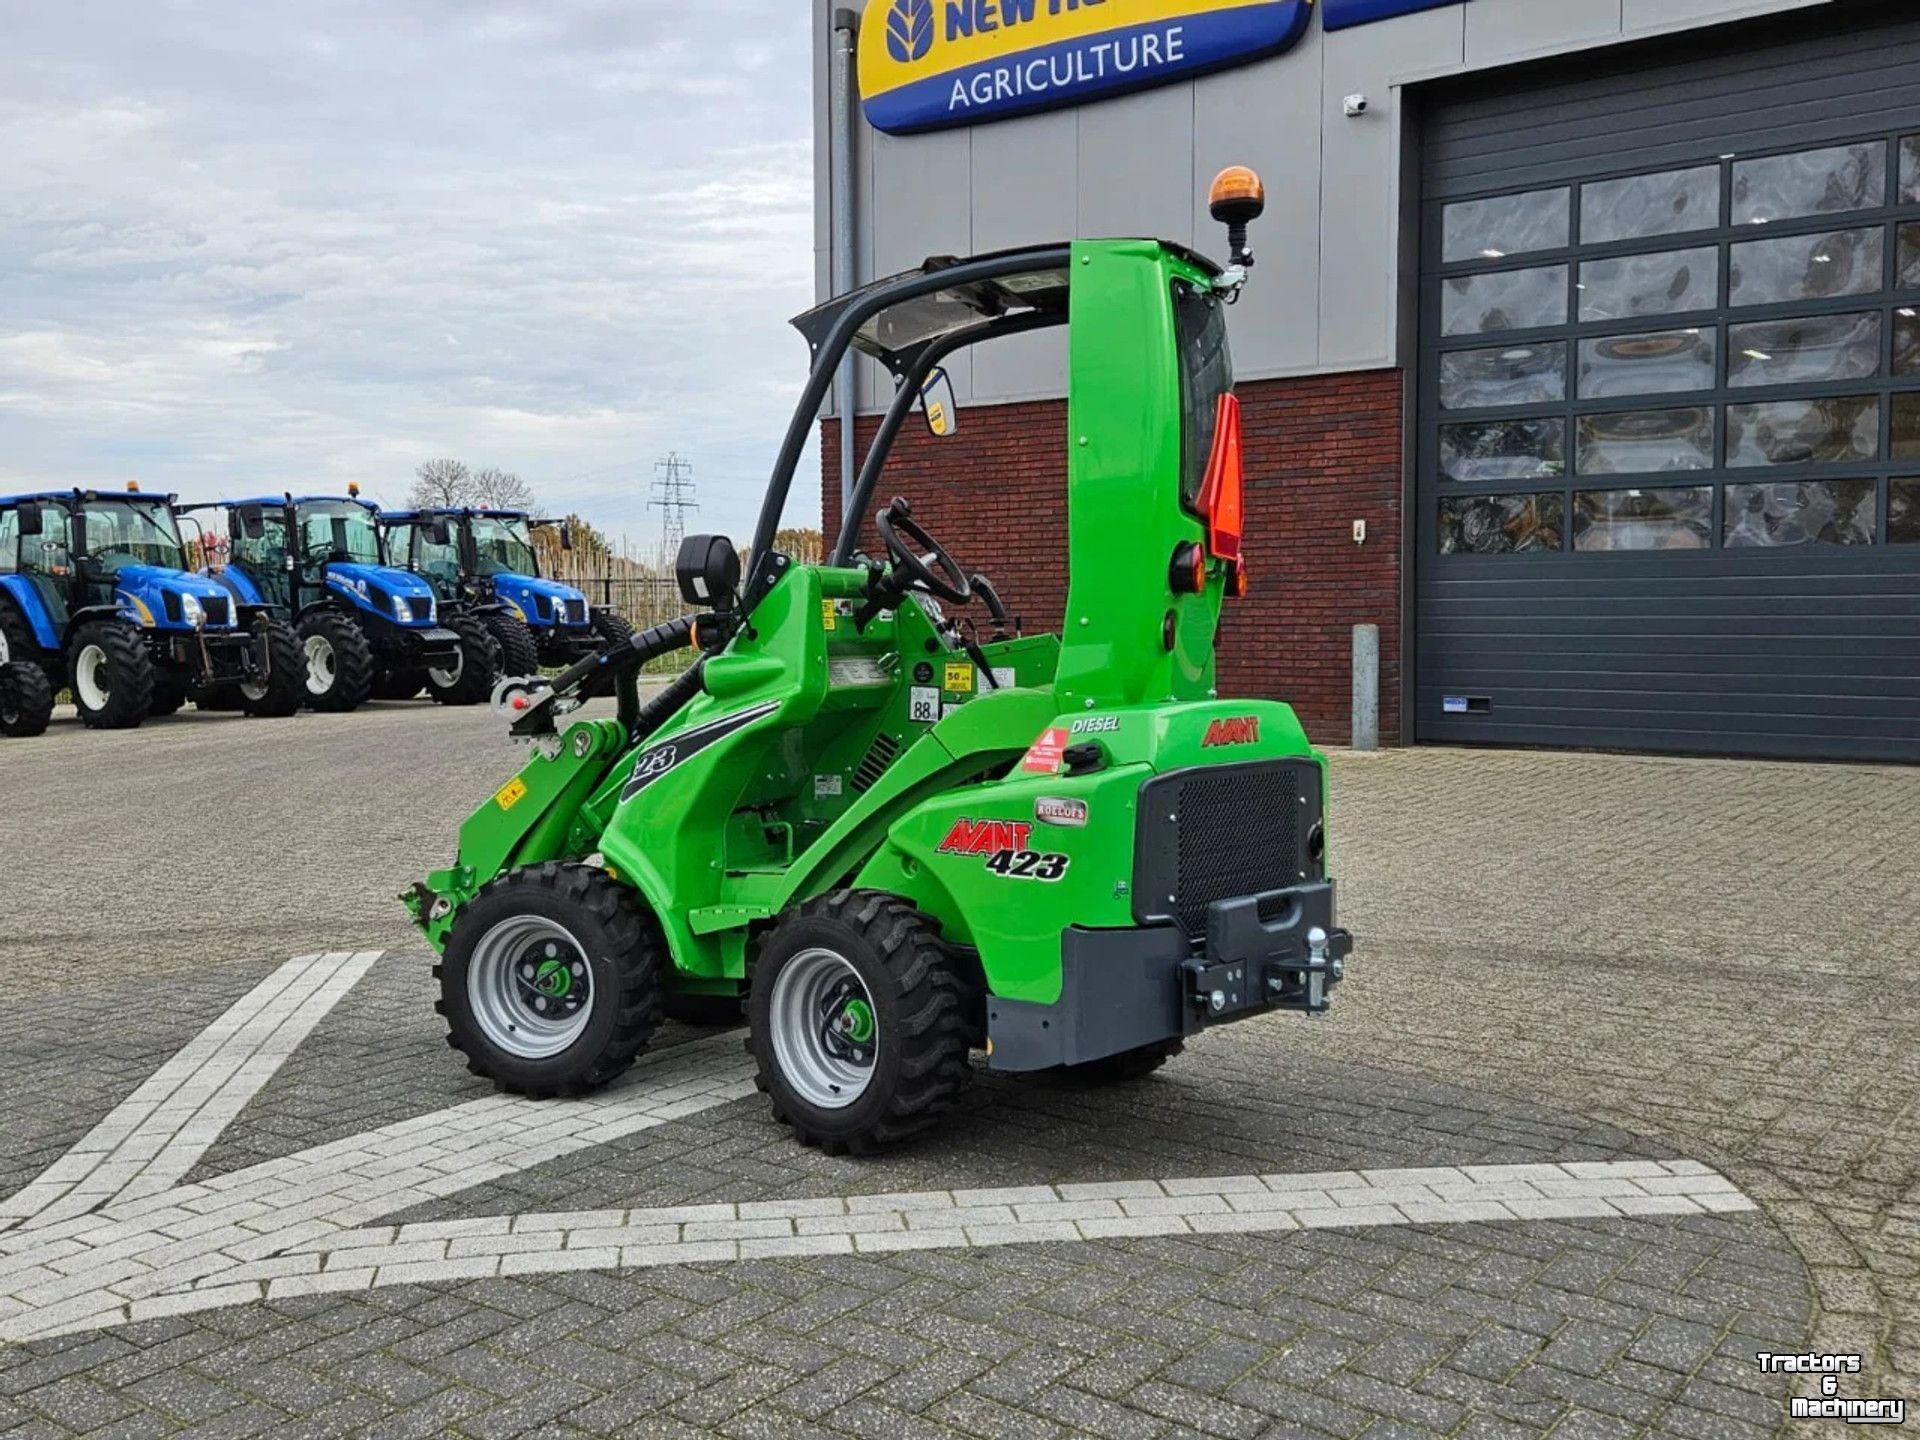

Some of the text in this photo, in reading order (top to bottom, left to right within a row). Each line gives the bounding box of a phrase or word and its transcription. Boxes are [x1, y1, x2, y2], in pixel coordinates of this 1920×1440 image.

[946, 0, 1035, 42] NEW
[949, 27, 1184, 110] AGRICULTURE
[914, 701, 931, 719] 88
[1072, 716, 1120, 734] DIESEL
[1201, 715, 1259, 748] AVANT
[936, 817, 1033, 857] AVANT
[985, 849, 1070, 881] 423
